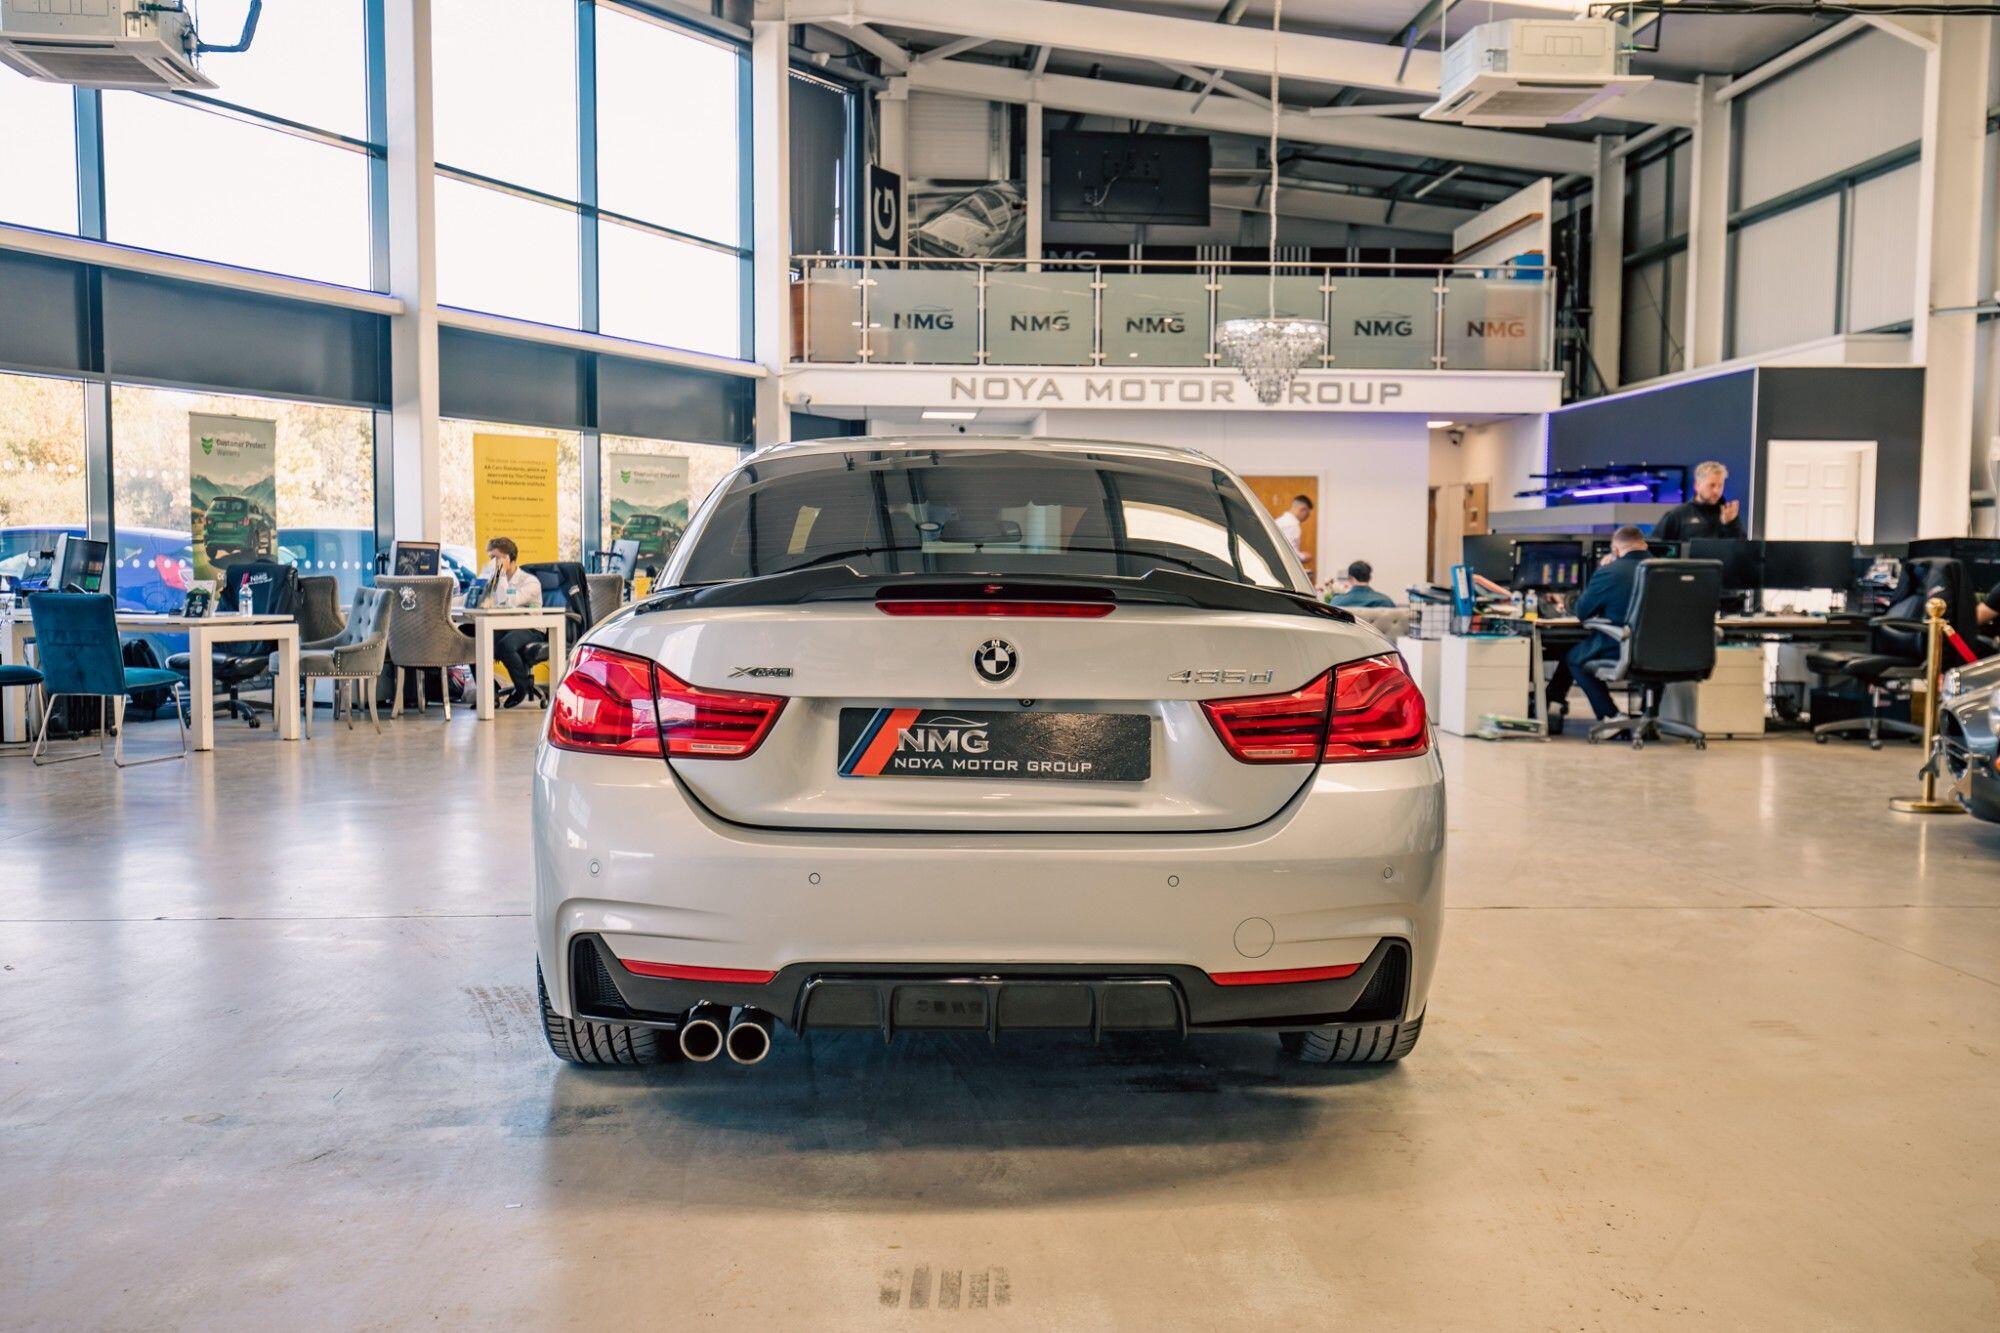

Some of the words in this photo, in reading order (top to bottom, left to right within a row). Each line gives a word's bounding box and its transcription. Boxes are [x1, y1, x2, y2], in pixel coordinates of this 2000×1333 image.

[1043, 250, 1097, 270] MG
[894, 313, 954, 330] NMG
[1010, 315, 1070, 331] NMG
[1126, 317, 1186, 333] NMG
[1354, 320, 1413, 336] NMG
[1467, 321, 1526, 337] NMG
[951, 376, 1063, 401] NOYA
[1085, 378, 1235, 403] MOTOR
[1258, 381, 1403, 405] ROUP
[978, 639, 1015, 654] BMW
[1167, 669, 1274, 684] 435d
[896, 728, 989, 753] NMG
[894, 758, 944, 769] NOYA
[952, 759, 1018, 771] MOTOR
[1027, 761, 1093, 773] GROUP
